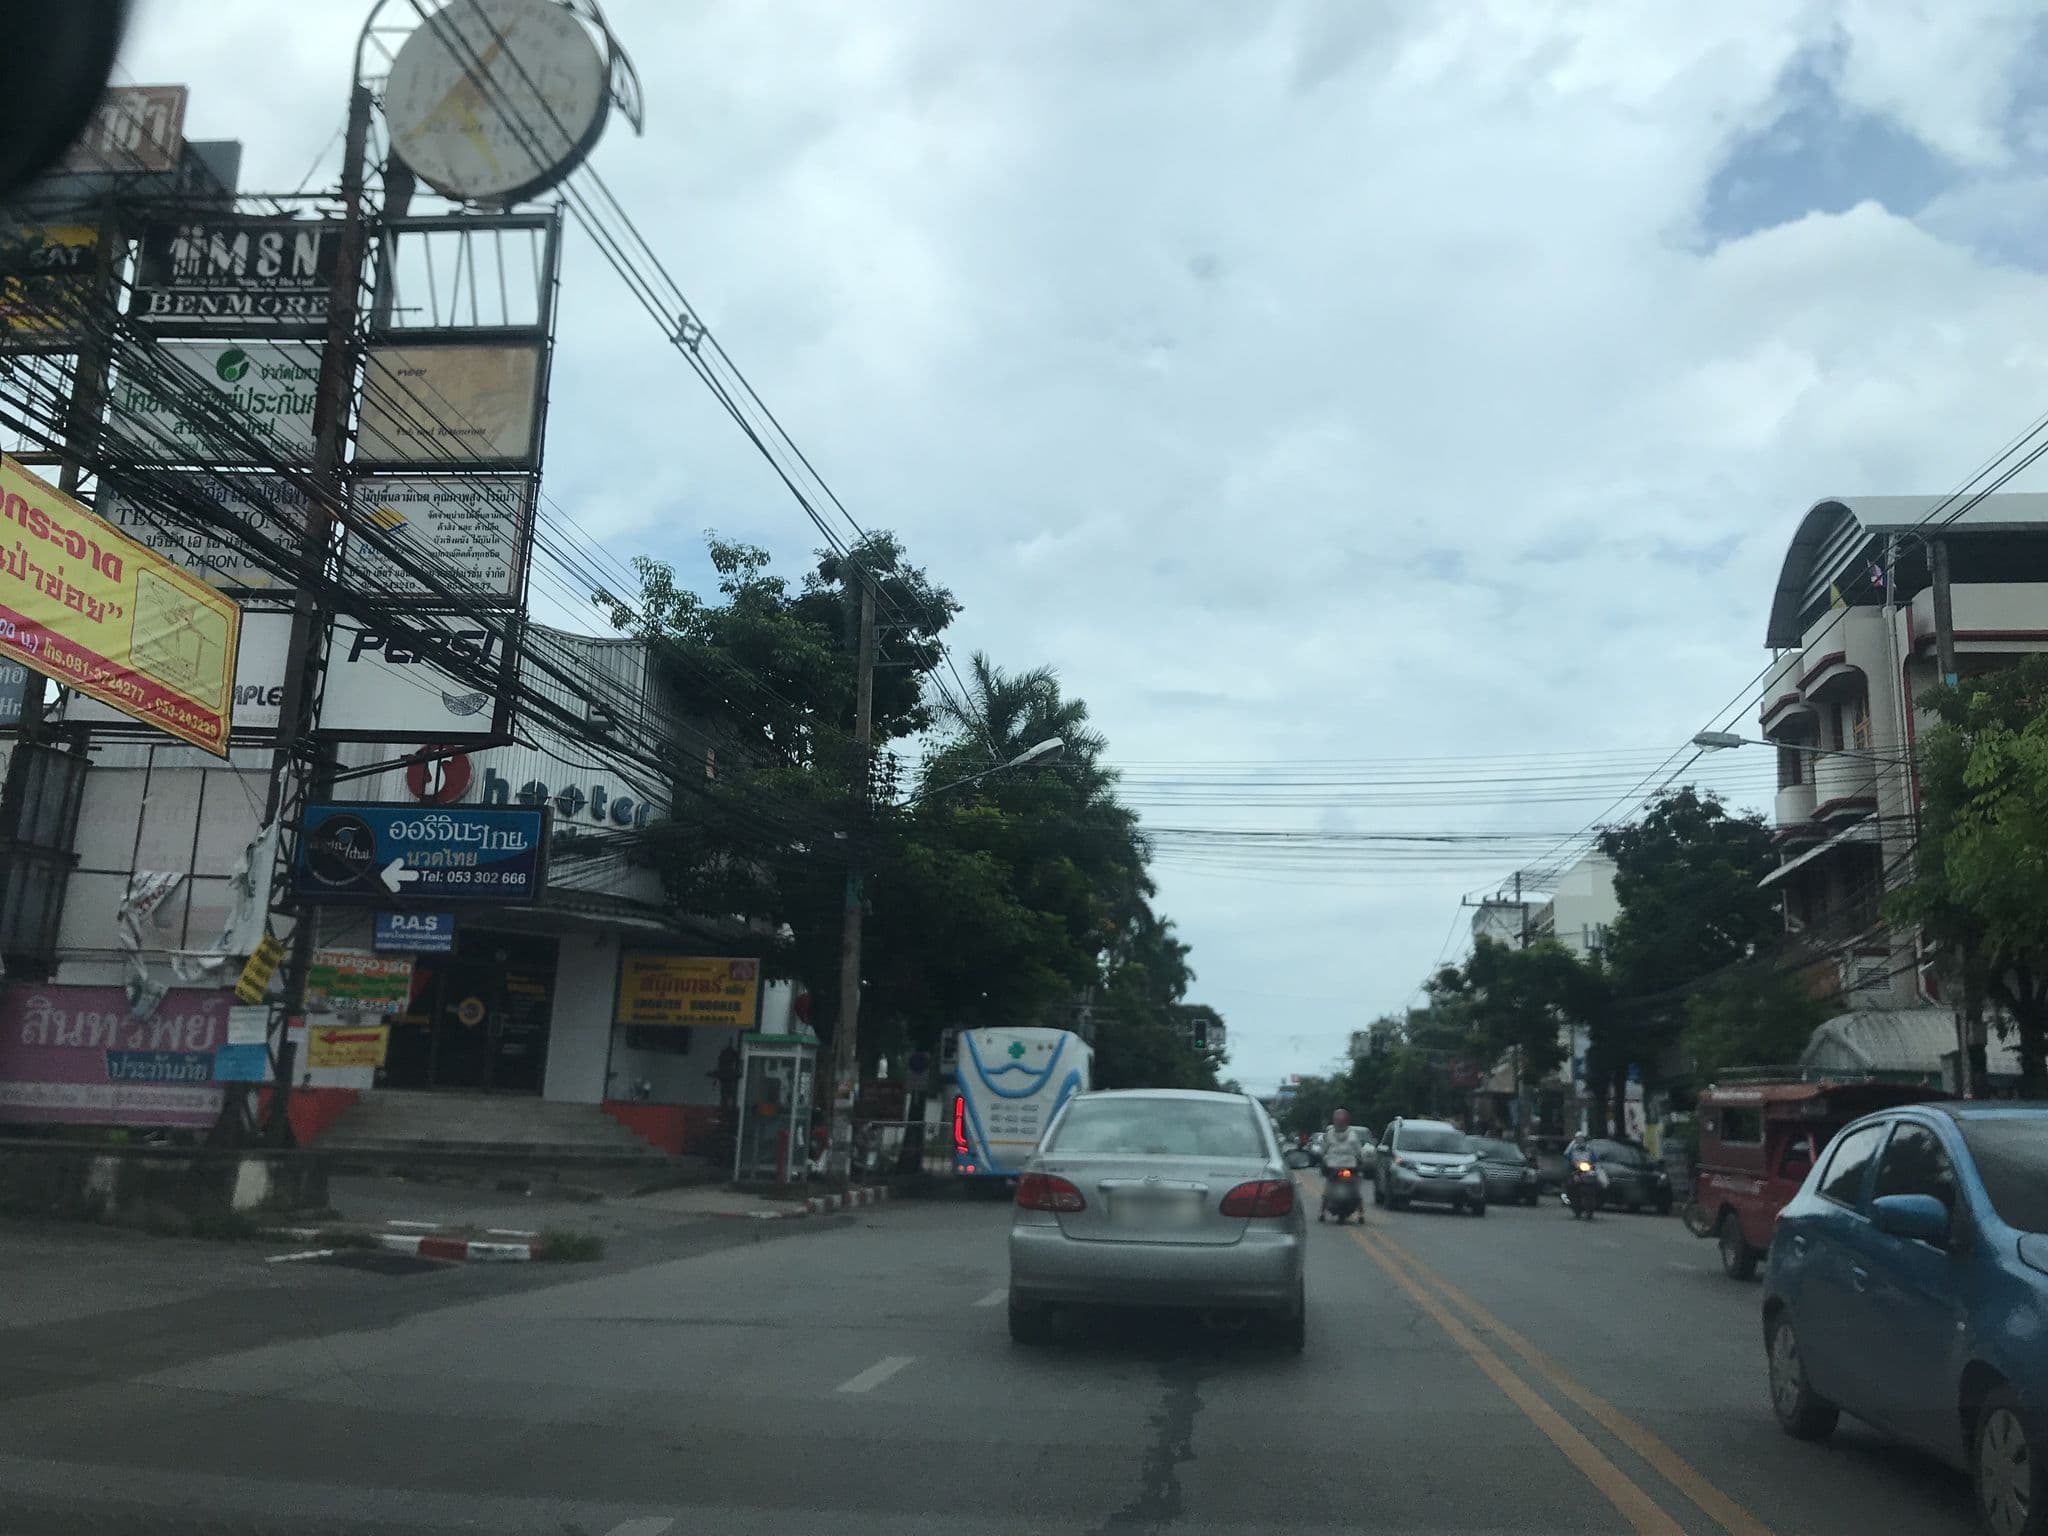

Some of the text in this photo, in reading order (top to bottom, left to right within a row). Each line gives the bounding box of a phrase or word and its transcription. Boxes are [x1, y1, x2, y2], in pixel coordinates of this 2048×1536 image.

[207, 228, 321, 277] MSN
[147, 294, 330, 315] BENMORE
[185, 554, 238, 569] AARON
[406, 848, 478, 868] นวดไทย
[421, 870, 527, 885] Tel: 053 302 666
